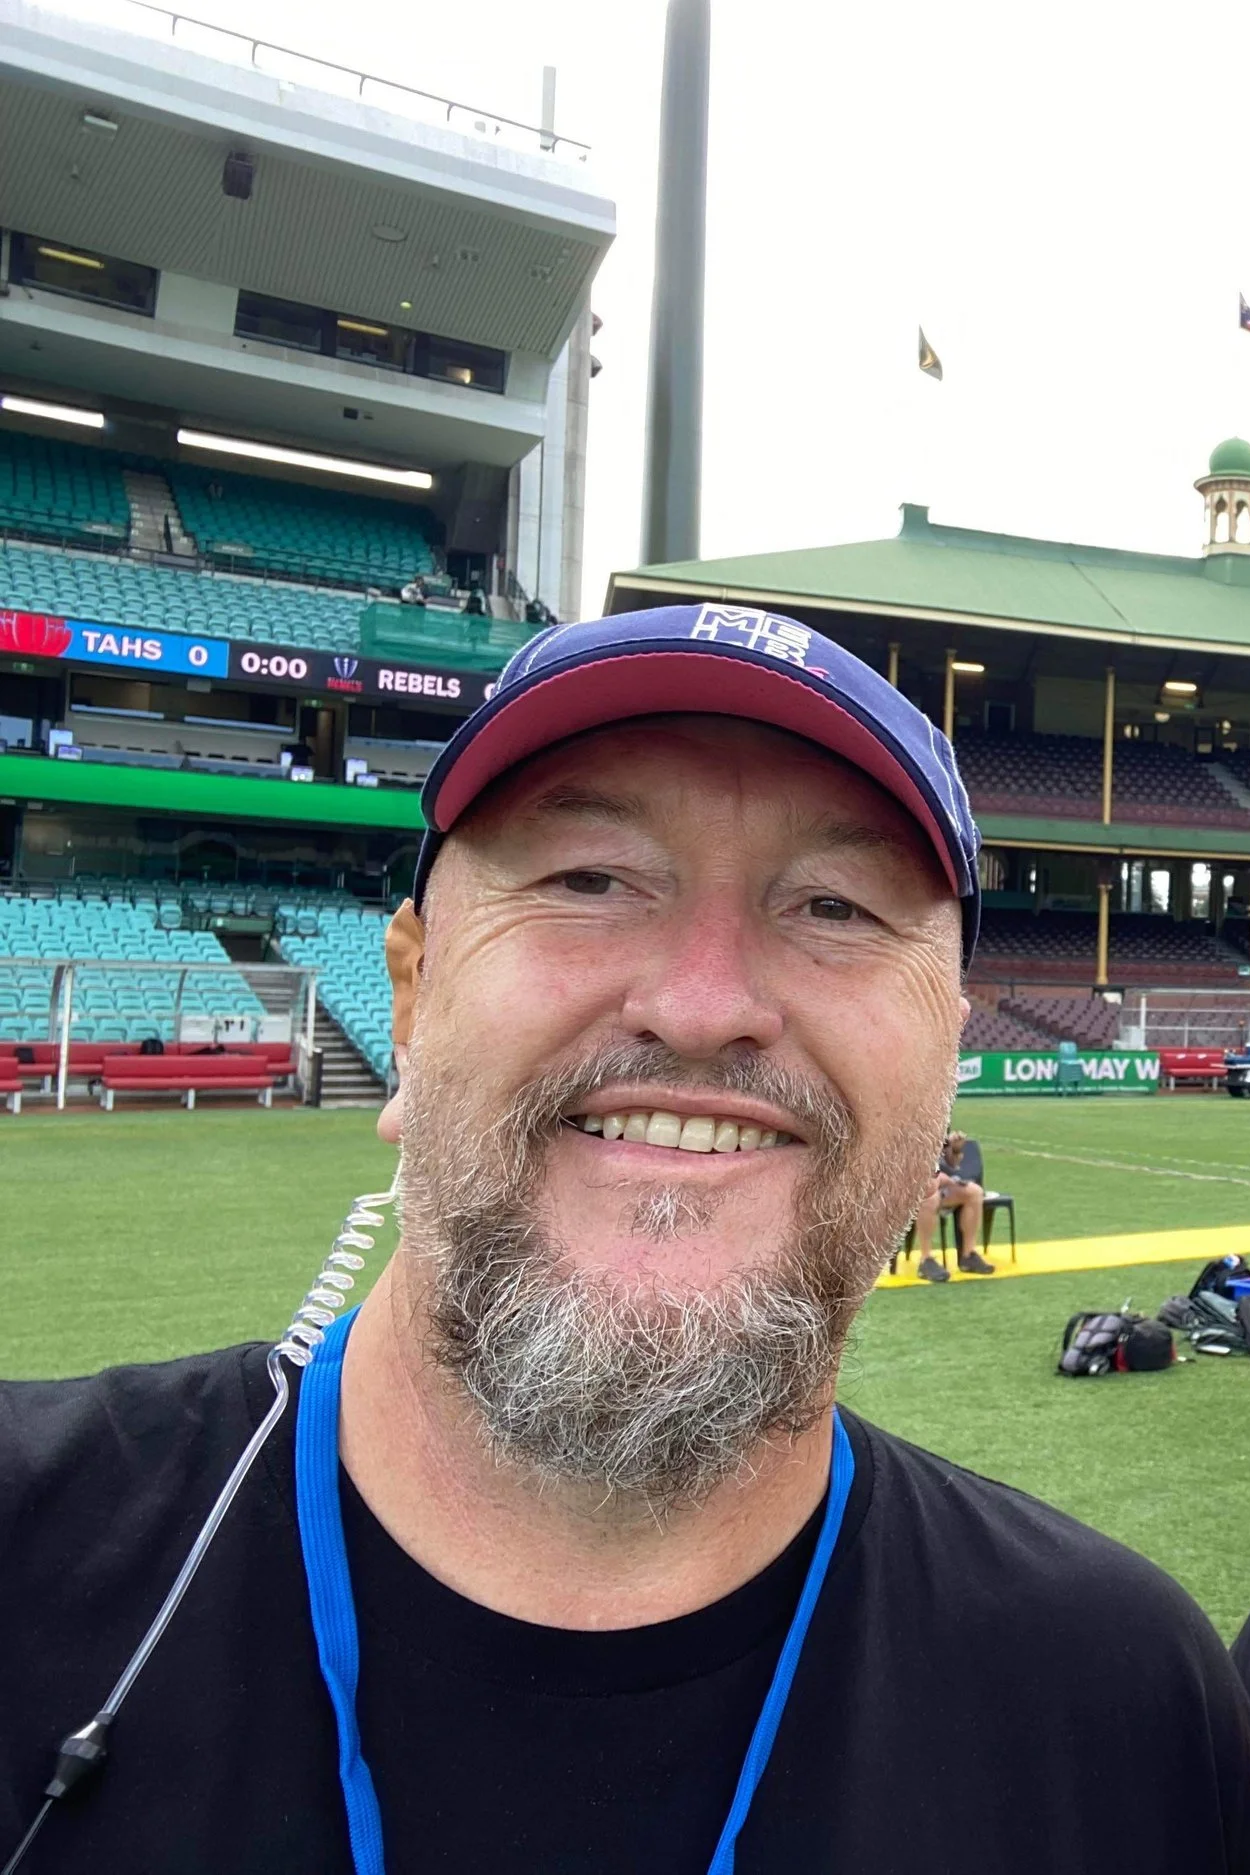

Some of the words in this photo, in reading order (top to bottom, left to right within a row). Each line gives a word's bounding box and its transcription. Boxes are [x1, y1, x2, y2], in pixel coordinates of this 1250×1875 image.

[81, 630, 162, 661] TAHS
[188, 645, 208, 666] 0
[241, 652, 308, 679] 0:00
[378, 669, 462, 698] REBELS
[1079, 1058, 1131, 1080] MAY
